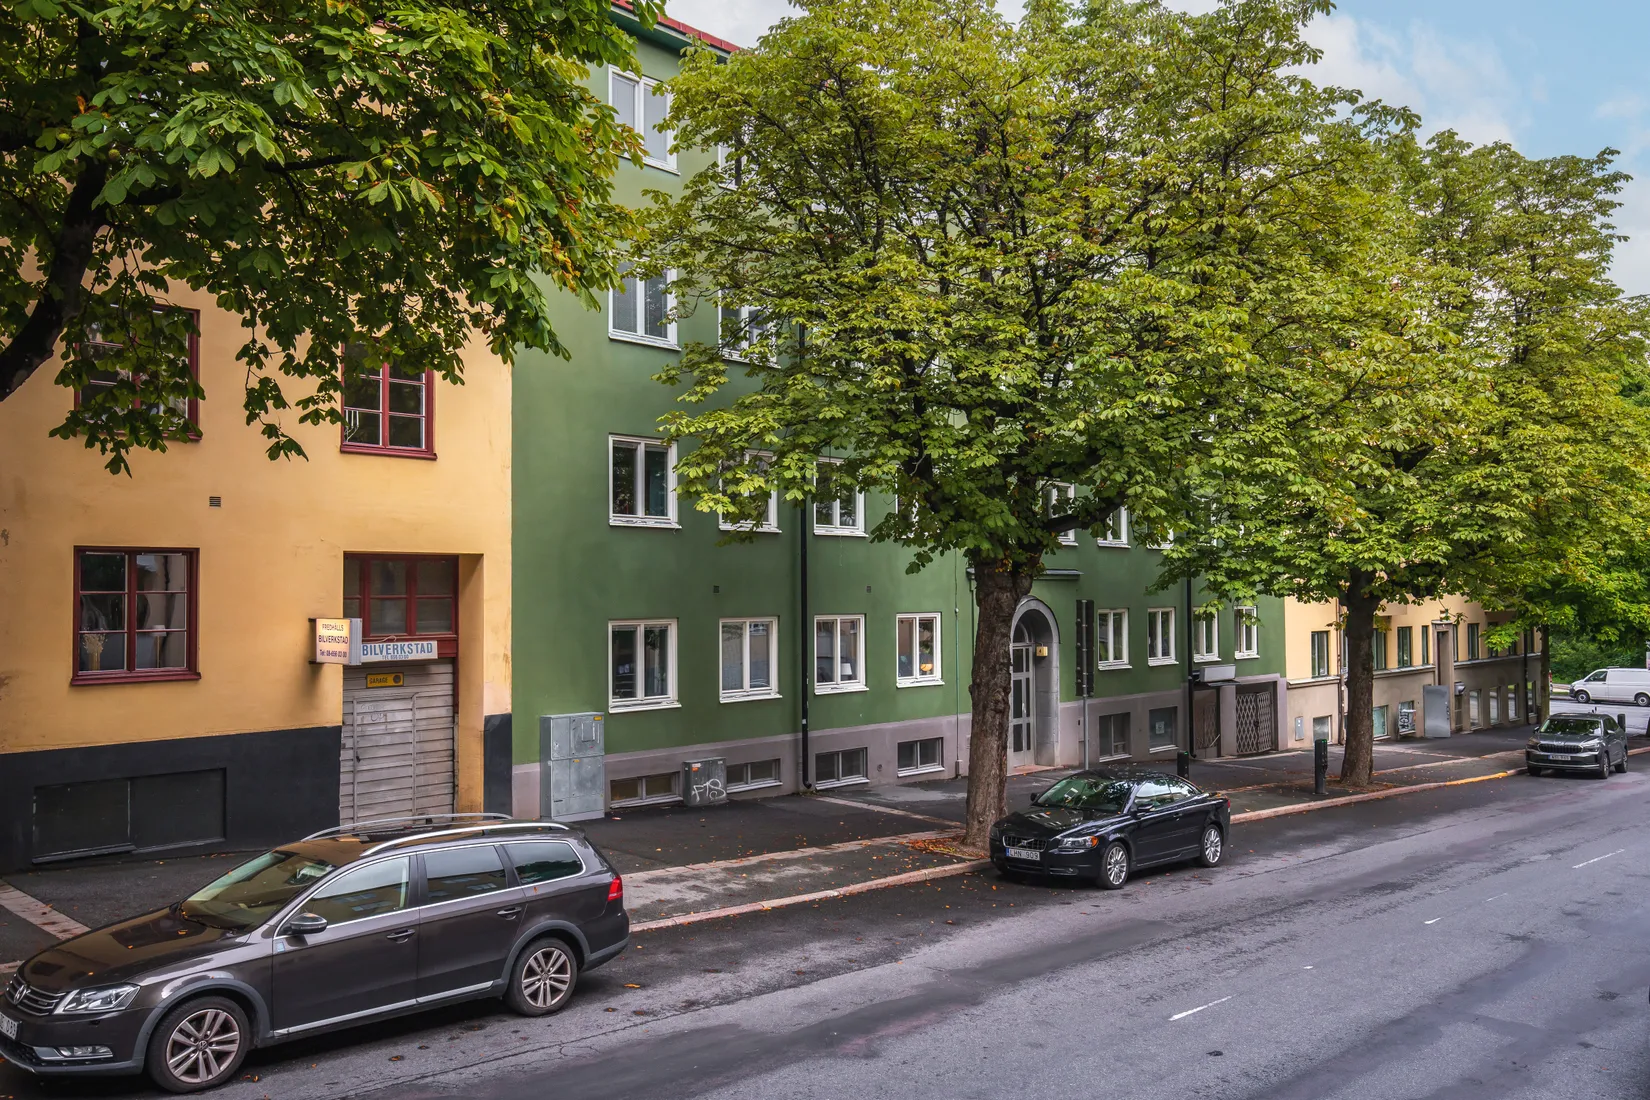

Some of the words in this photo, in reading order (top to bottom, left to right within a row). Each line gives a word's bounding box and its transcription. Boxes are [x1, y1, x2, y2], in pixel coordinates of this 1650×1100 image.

[318, 634, 348, 644] BILVERKSTAD
[362, 642, 433, 656] BILVERKSTAD
[369, 676, 388, 685] GARAGE
